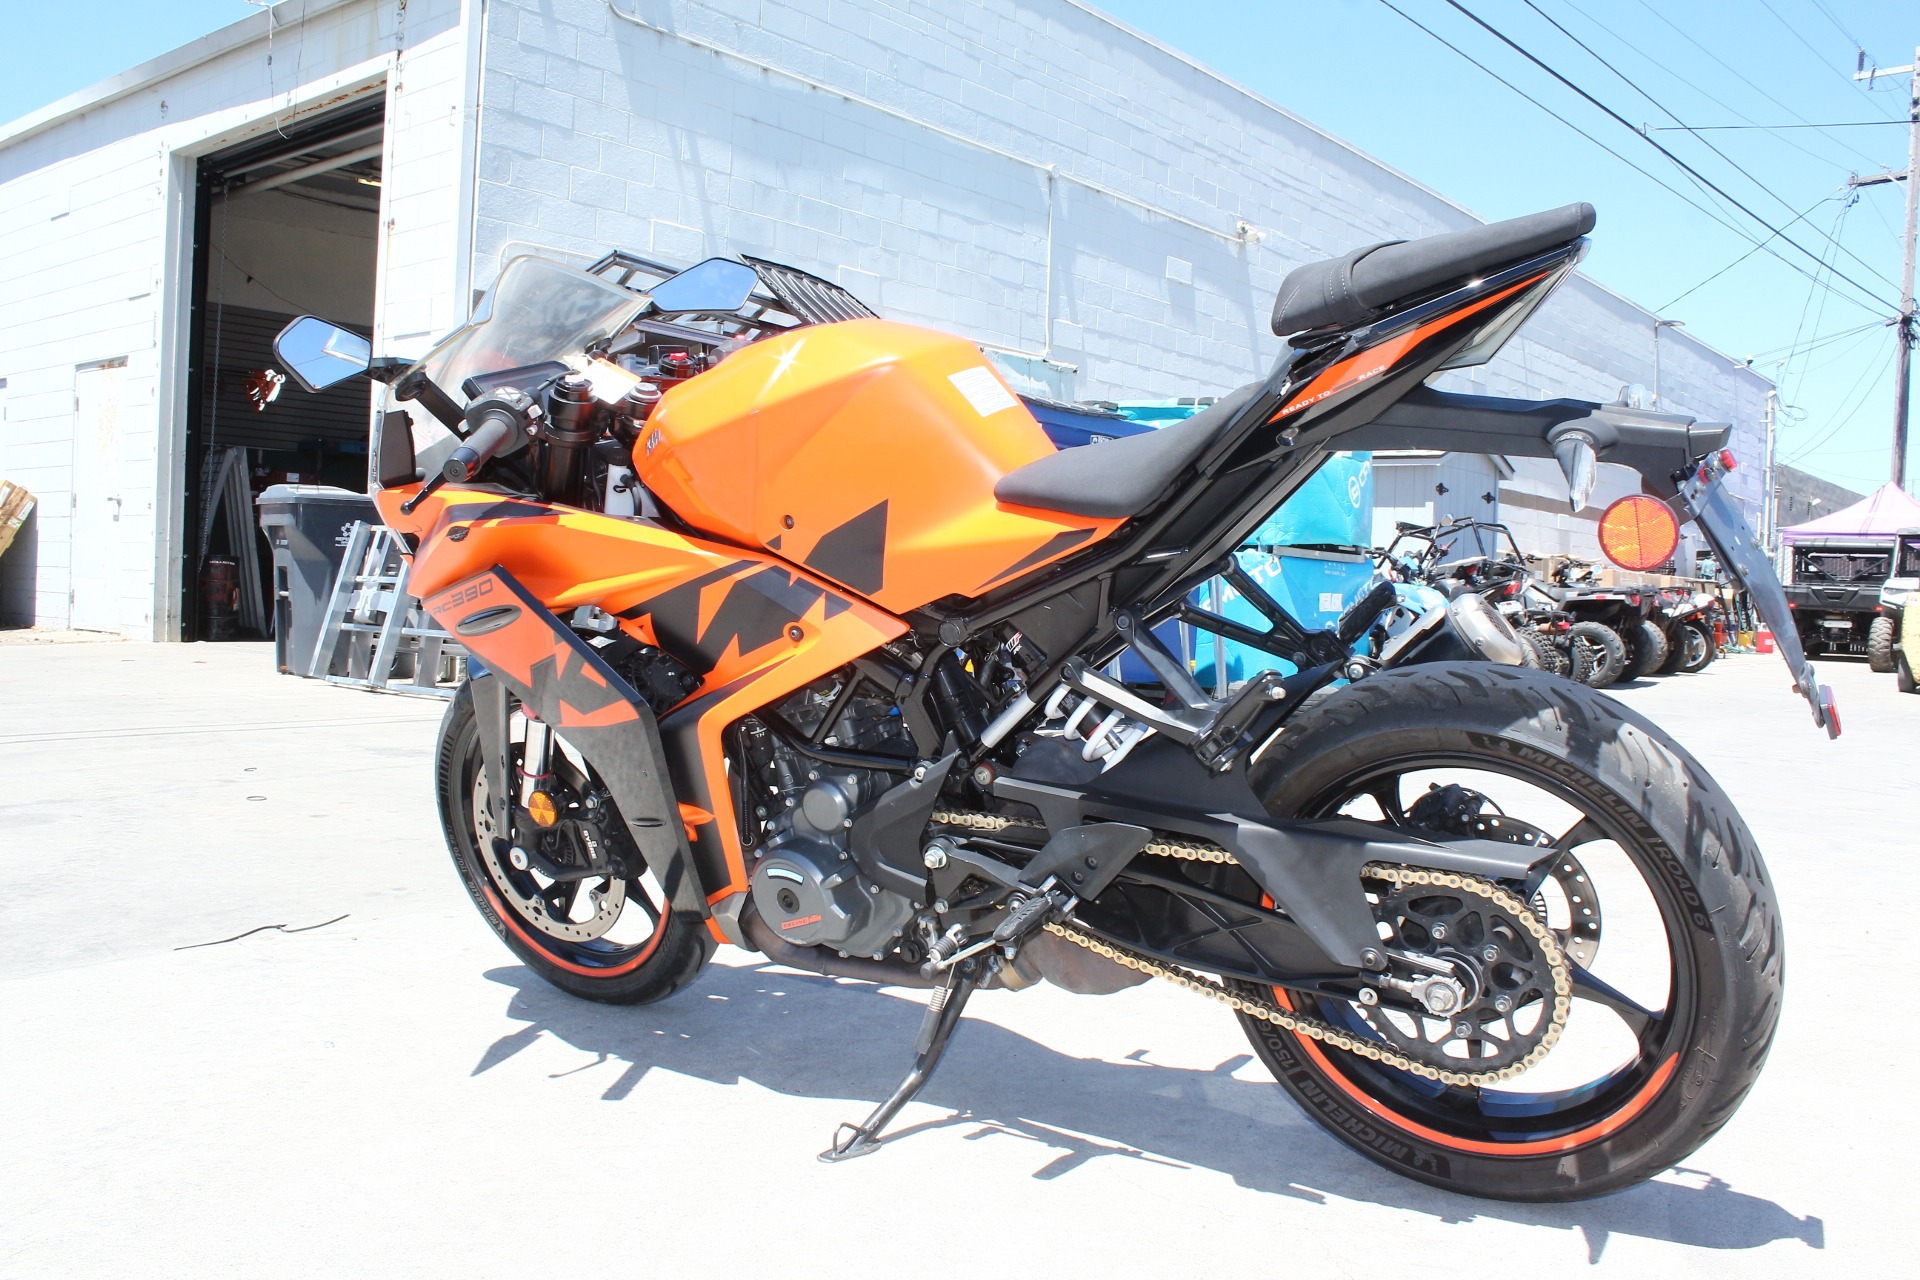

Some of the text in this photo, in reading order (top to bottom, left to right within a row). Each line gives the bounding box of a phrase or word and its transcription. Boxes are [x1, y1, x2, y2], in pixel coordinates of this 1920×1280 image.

[1282, 364, 1386, 415] READY TO RACE
[1519, 747, 1710, 929] MICHELIN ROAD 6
[1256, 1020, 1409, 1159] MICHELIN 150/6
